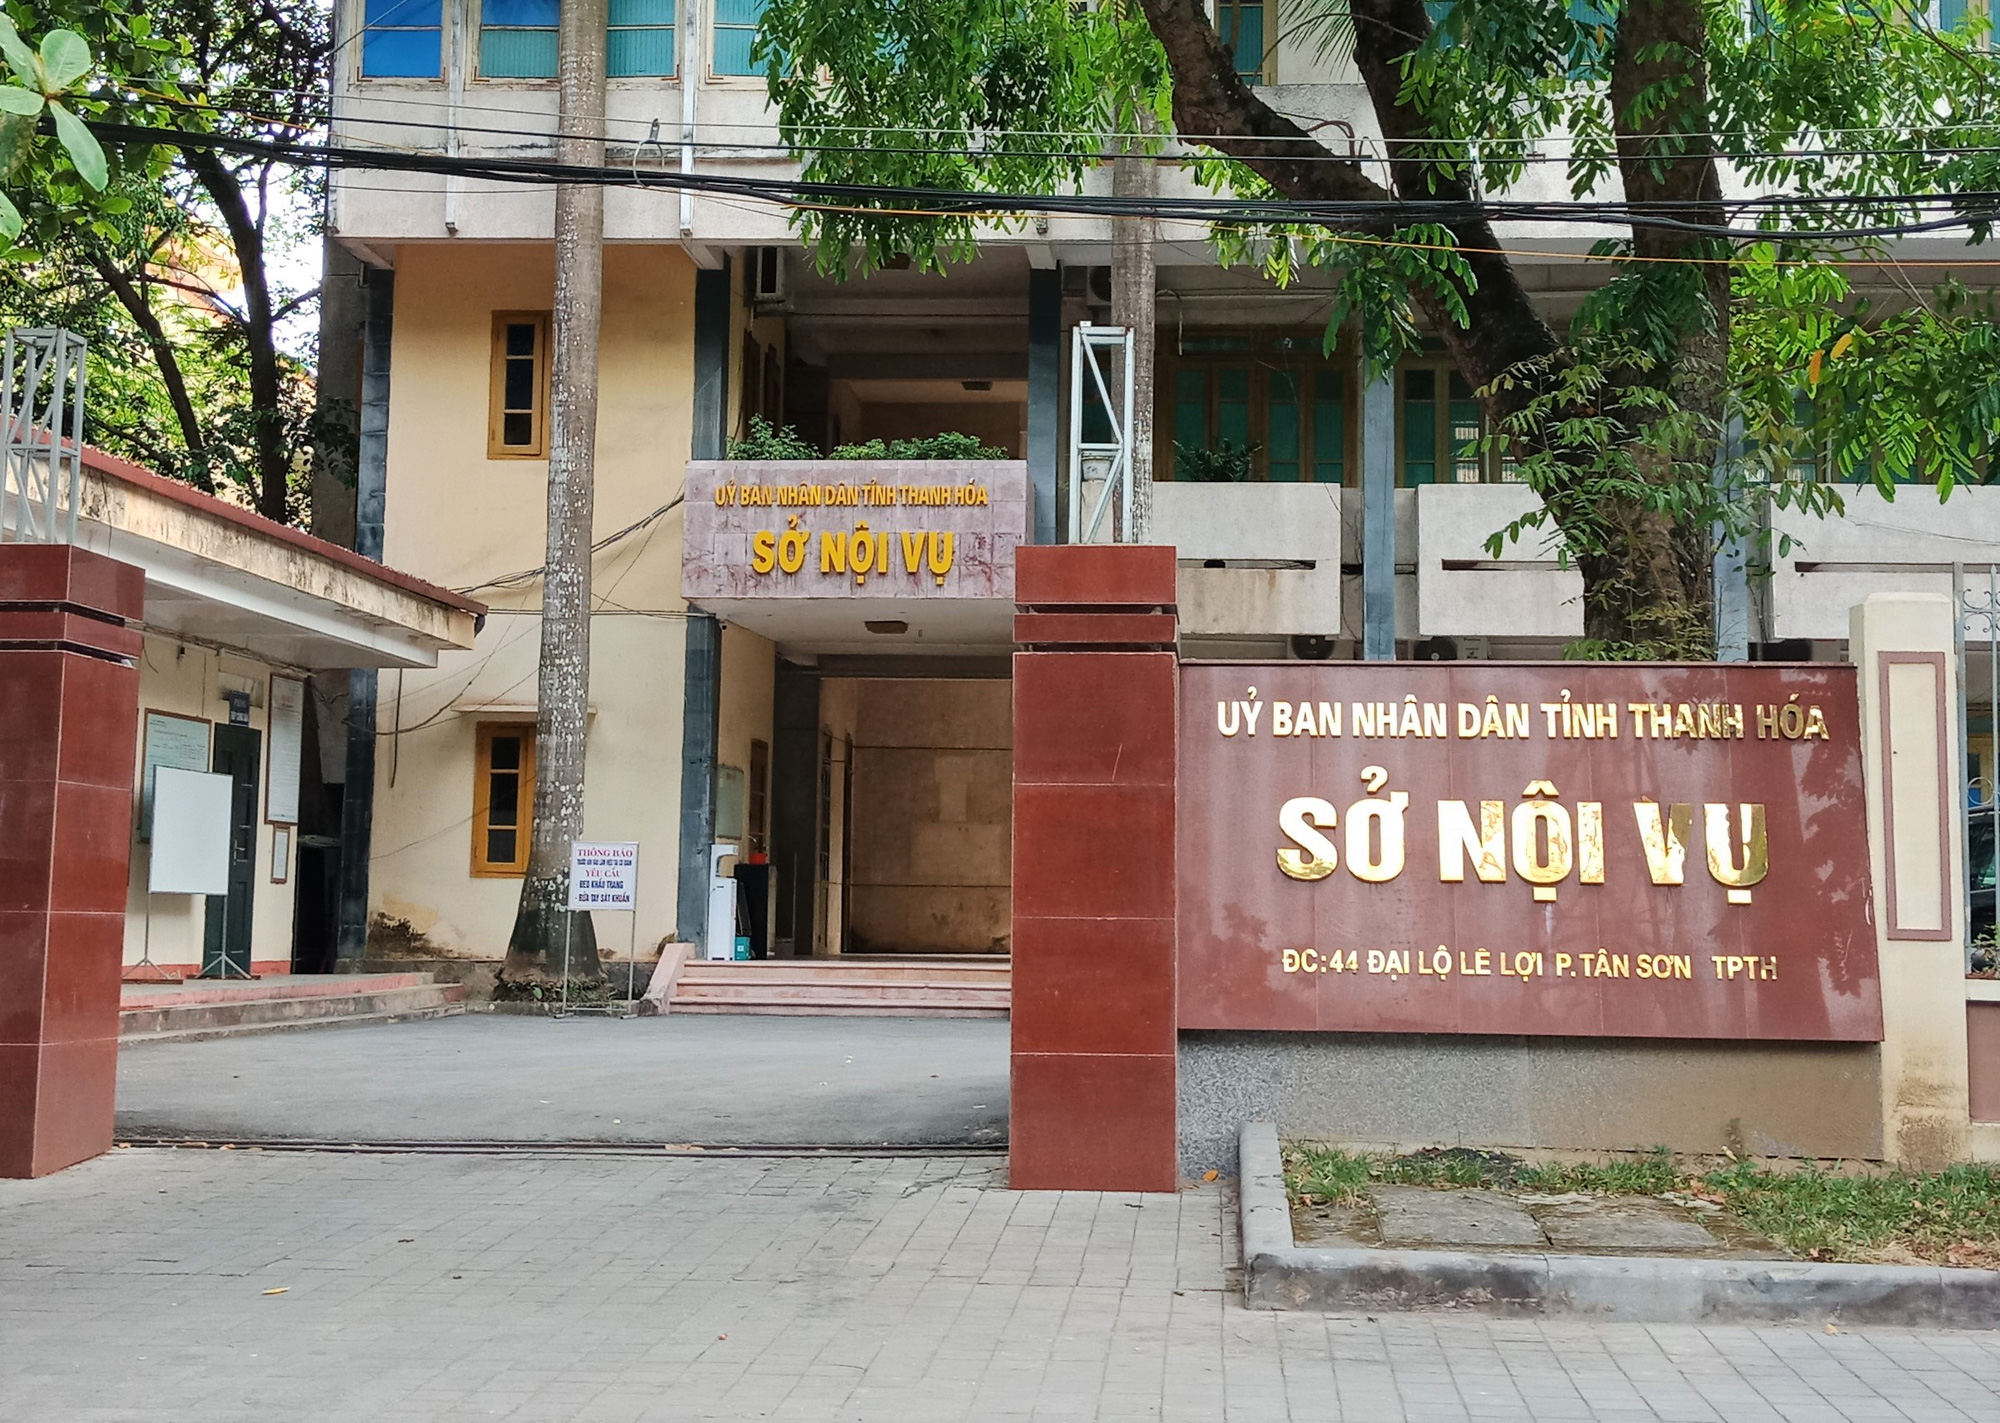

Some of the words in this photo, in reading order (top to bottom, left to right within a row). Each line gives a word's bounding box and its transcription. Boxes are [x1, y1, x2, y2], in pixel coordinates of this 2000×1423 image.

[715, 477, 737, 506] UỶ
[740, 484, 773, 506] BAN
[777, 480, 821, 506] NHÂN
[825, 480, 858, 506] DÂN
[861, 477, 896, 506] TỈNH
[900, 484, 951, 506] THANH
[955, 477, 988, 506] HÓA
[752, 514, 811, 574] SỞ
[820, 520, 888, 585] NỘI
[901, 531, 954, 586] VỤ
[1217, 686, 1263, 737] UỶ
[1273, 701, 1342, 737] BAN
[1352, 694, 1447, 738] NHÂN
[1458, 694, 1530, 739] DÂN
[1541, 688, 1618, 739] TỈNH
[1628, 702, 1744, 739] THANH
[1756, 693, 1830, 741] HÓA
[577, 846, 610, 857] THÔNG
[1276, 765, 1410, 883] SỞ
[1437, 780, 1605, 902] NỘI
[1633, 801, 1769, 905] VỤ
[1282, 948, 1359, 974] ĐC:44
[1367, 949, 1411, 981] ĐẠI
[1418, 944, 1452, 981] LỘ
[1460, 948, 1491, 976] LÊ
[1501, 951, 1543, 982] LỢI
[1636, 953, 1692, 979] SƠN
[1711, 955, 1778, 980] TPTH
